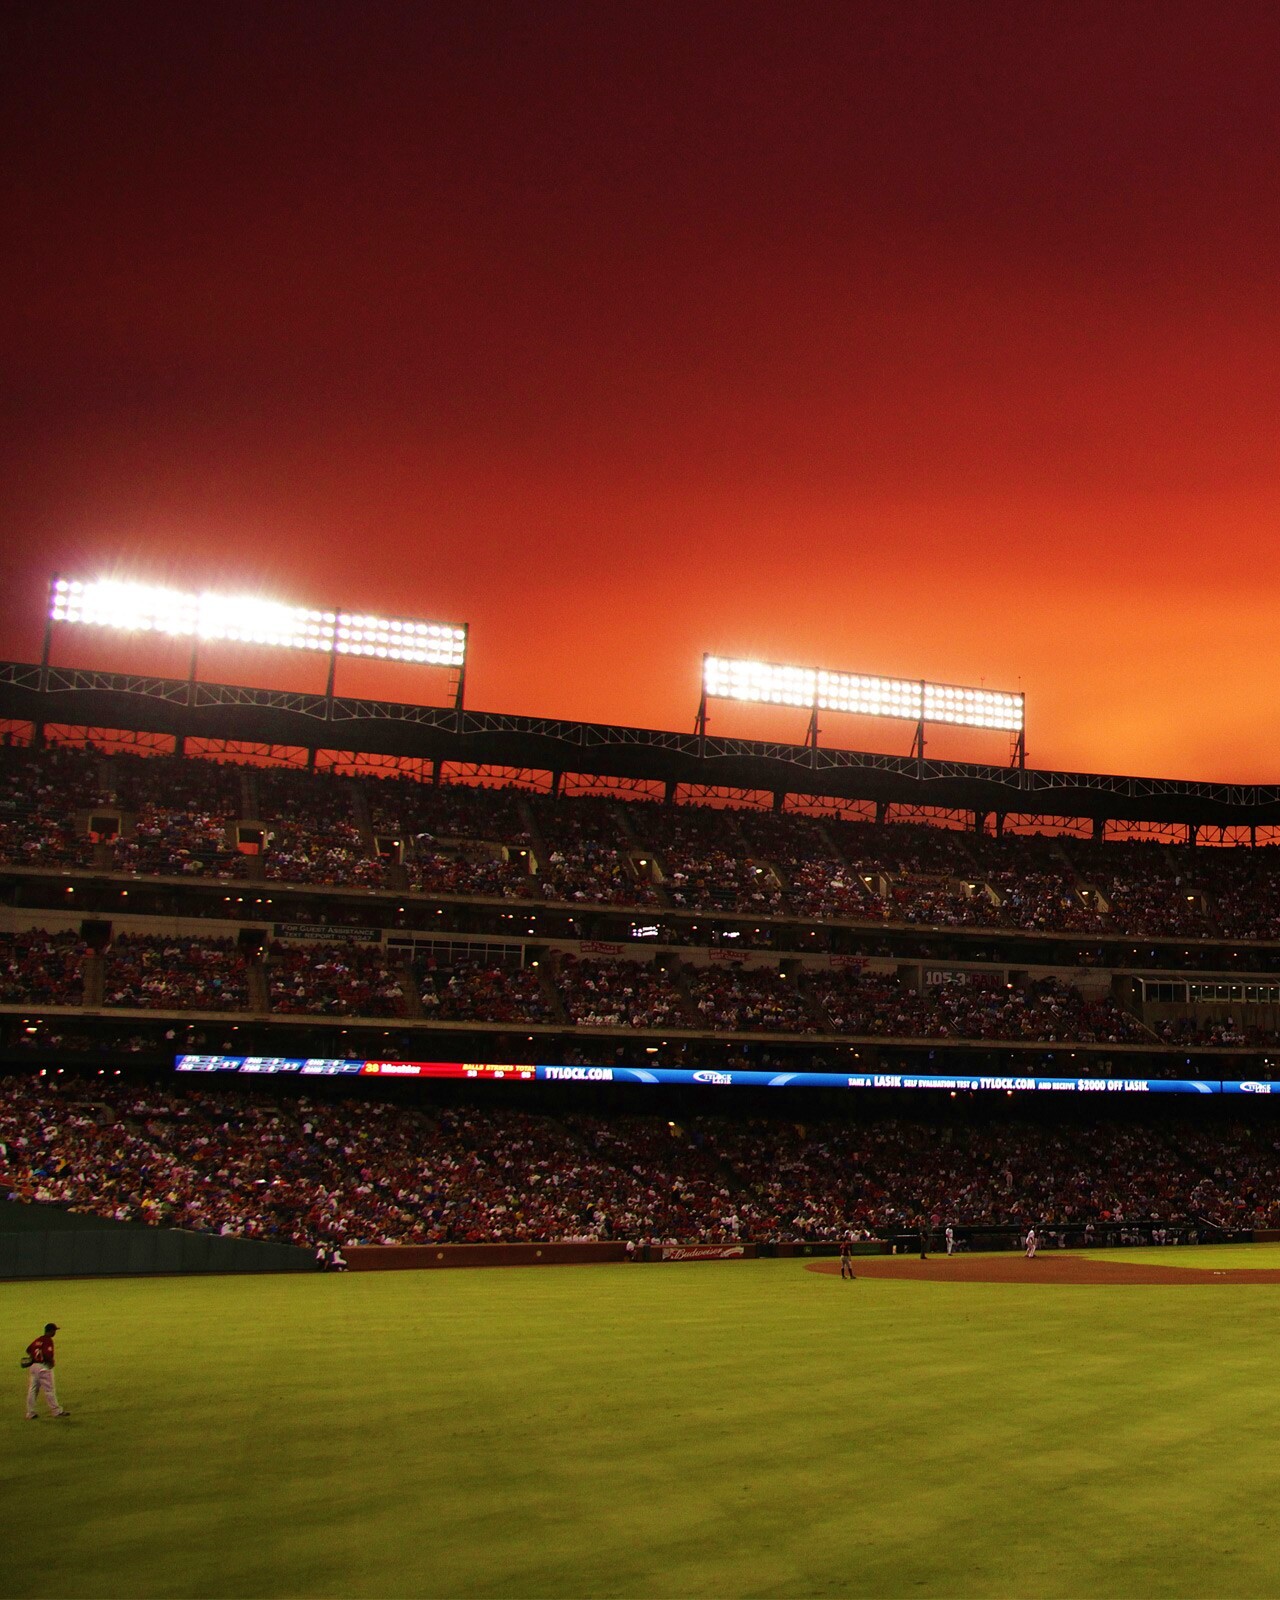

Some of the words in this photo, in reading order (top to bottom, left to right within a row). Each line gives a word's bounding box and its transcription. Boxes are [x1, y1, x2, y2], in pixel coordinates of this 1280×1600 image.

[365, 1063, 379, 1072] 38
[545, 1067, 612, 1080] TYLOCK.COM
[874, 1076, 901, 1086] LASIK
[971, 1081, 978, 1089] @
[980, 1078, 1035, 1089] TYLOCK.COM
[1078, 1079, 1105, 1091] $2000
[1108, 1080, 1122, 1090] OFF
[671, 1246, 723, 1260] Budweiser
